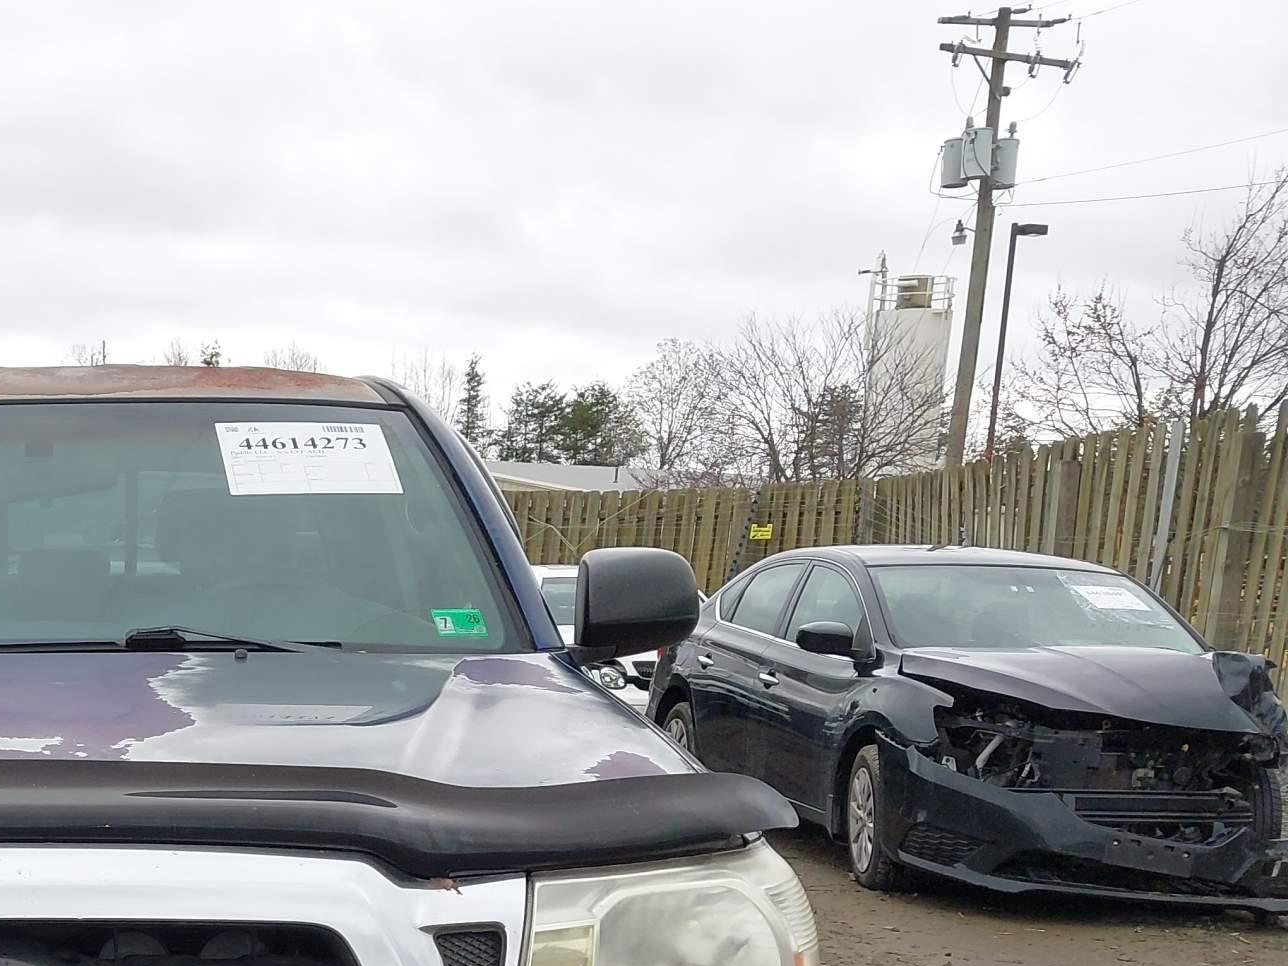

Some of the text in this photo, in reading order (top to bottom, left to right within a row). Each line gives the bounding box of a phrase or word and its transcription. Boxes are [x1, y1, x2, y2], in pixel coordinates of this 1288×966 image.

[238, 436, 368, 450] 44614273
[439, 613, 481, 629] 7 26
